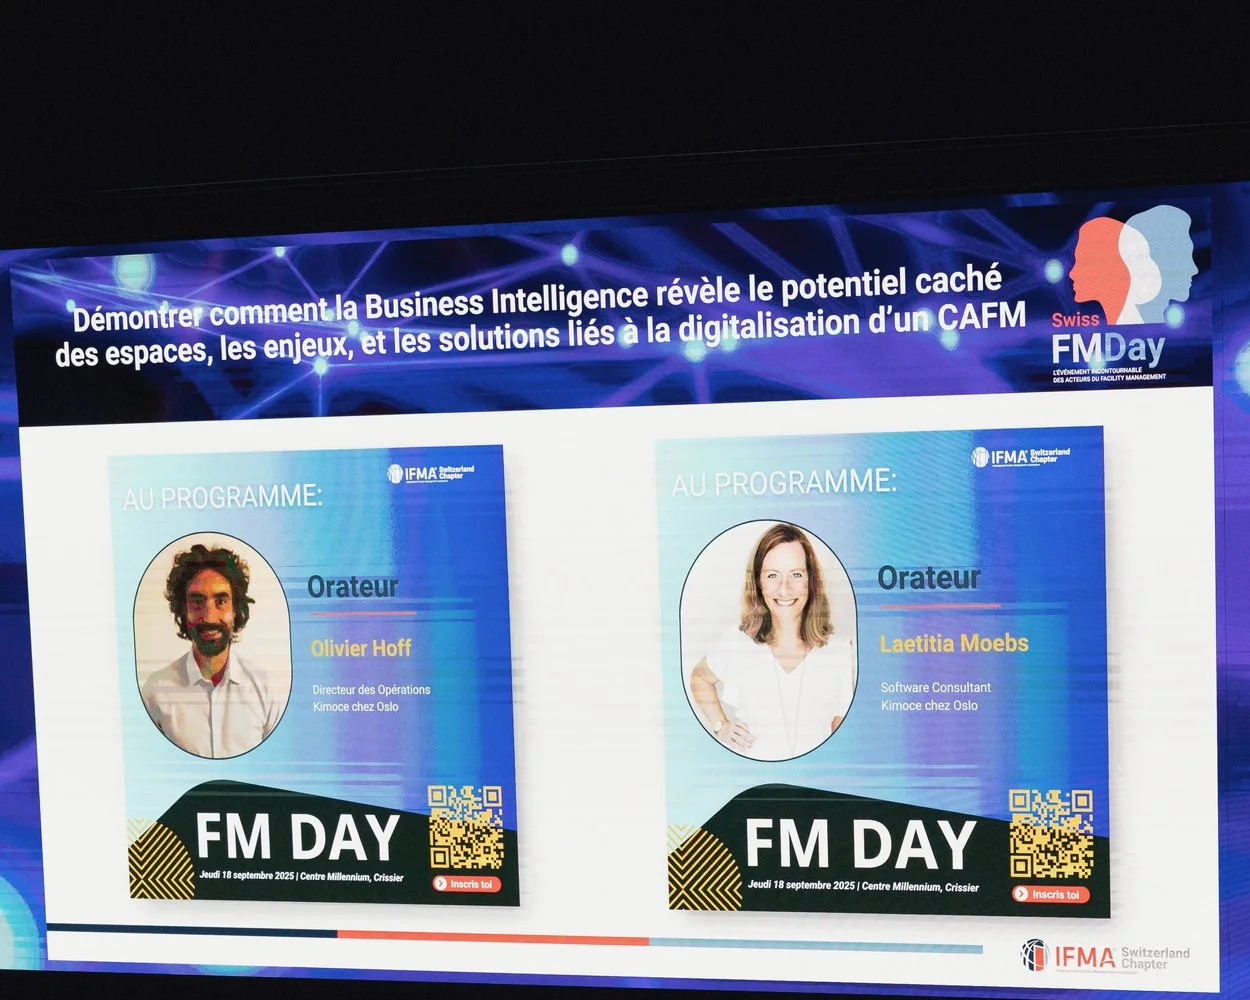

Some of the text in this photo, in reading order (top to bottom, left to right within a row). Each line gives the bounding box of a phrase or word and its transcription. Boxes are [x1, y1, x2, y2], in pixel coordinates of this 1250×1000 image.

[73, 262, 1002, 332] Démontrer comment la Business Intelligence révèle le potentiel caché
[1052, 312, 1100, 328] Swiss
[55, 301, 1026, 371] des espaces, les enjeux, et les solutions liés à la digitalisation d'un CAFM
[1052, 332, 1166, 368] FMDay
[1126, 373, 1166, 381] MANAGEMENT
[991, 450, 1027, 464] IFMA
[1030, 448, 1071, 456] Switzerland
[1030, 456, 1057, 464] Chapter
[405, 467, 437, 480] IFMA
[439, 465, 475, 473] Switzerland
[439, 472, 463, 480] Chapter
[672, 467, 897, 497] AU PROGRAMME:
[123, 483, 323, 511] AU PROGRAMME:
[878, 565, 981, 590] Orateur
[307, 574, 399, 599] Orateur
[310, 638, 412, 658] Olivier Hoff
[880, 632, 1029, 654] Laetitia Moebs
[312, 683, 431, 698] Directeur des Opérations
[881, 681, 991, 694] Software Consultant
[313, 700, 399, 712] Kimoce chez Oslo
[881, 700, 978, 712] Kimoce chez Oslo
[196, 812, 401, 861] FM DAY
[746, 818, 977, 870] FM DAY
[199, 870, 404, 883] Jeudi 18 septembre 2025 Centre Millennium, Crissier
[451, 880, 492, 889] Inscris toi
[748, 880, 979, 894] Jeudi 18 septembre 2025 Centre Millennium, Crissier
[1032, 889, 1080, 901] Inscris toi
[1055, 946, 1116, 968] IFMA
[1121, 947, 1190, 959] Switzerland
[1121, 958, 1168, 971] Chapter
